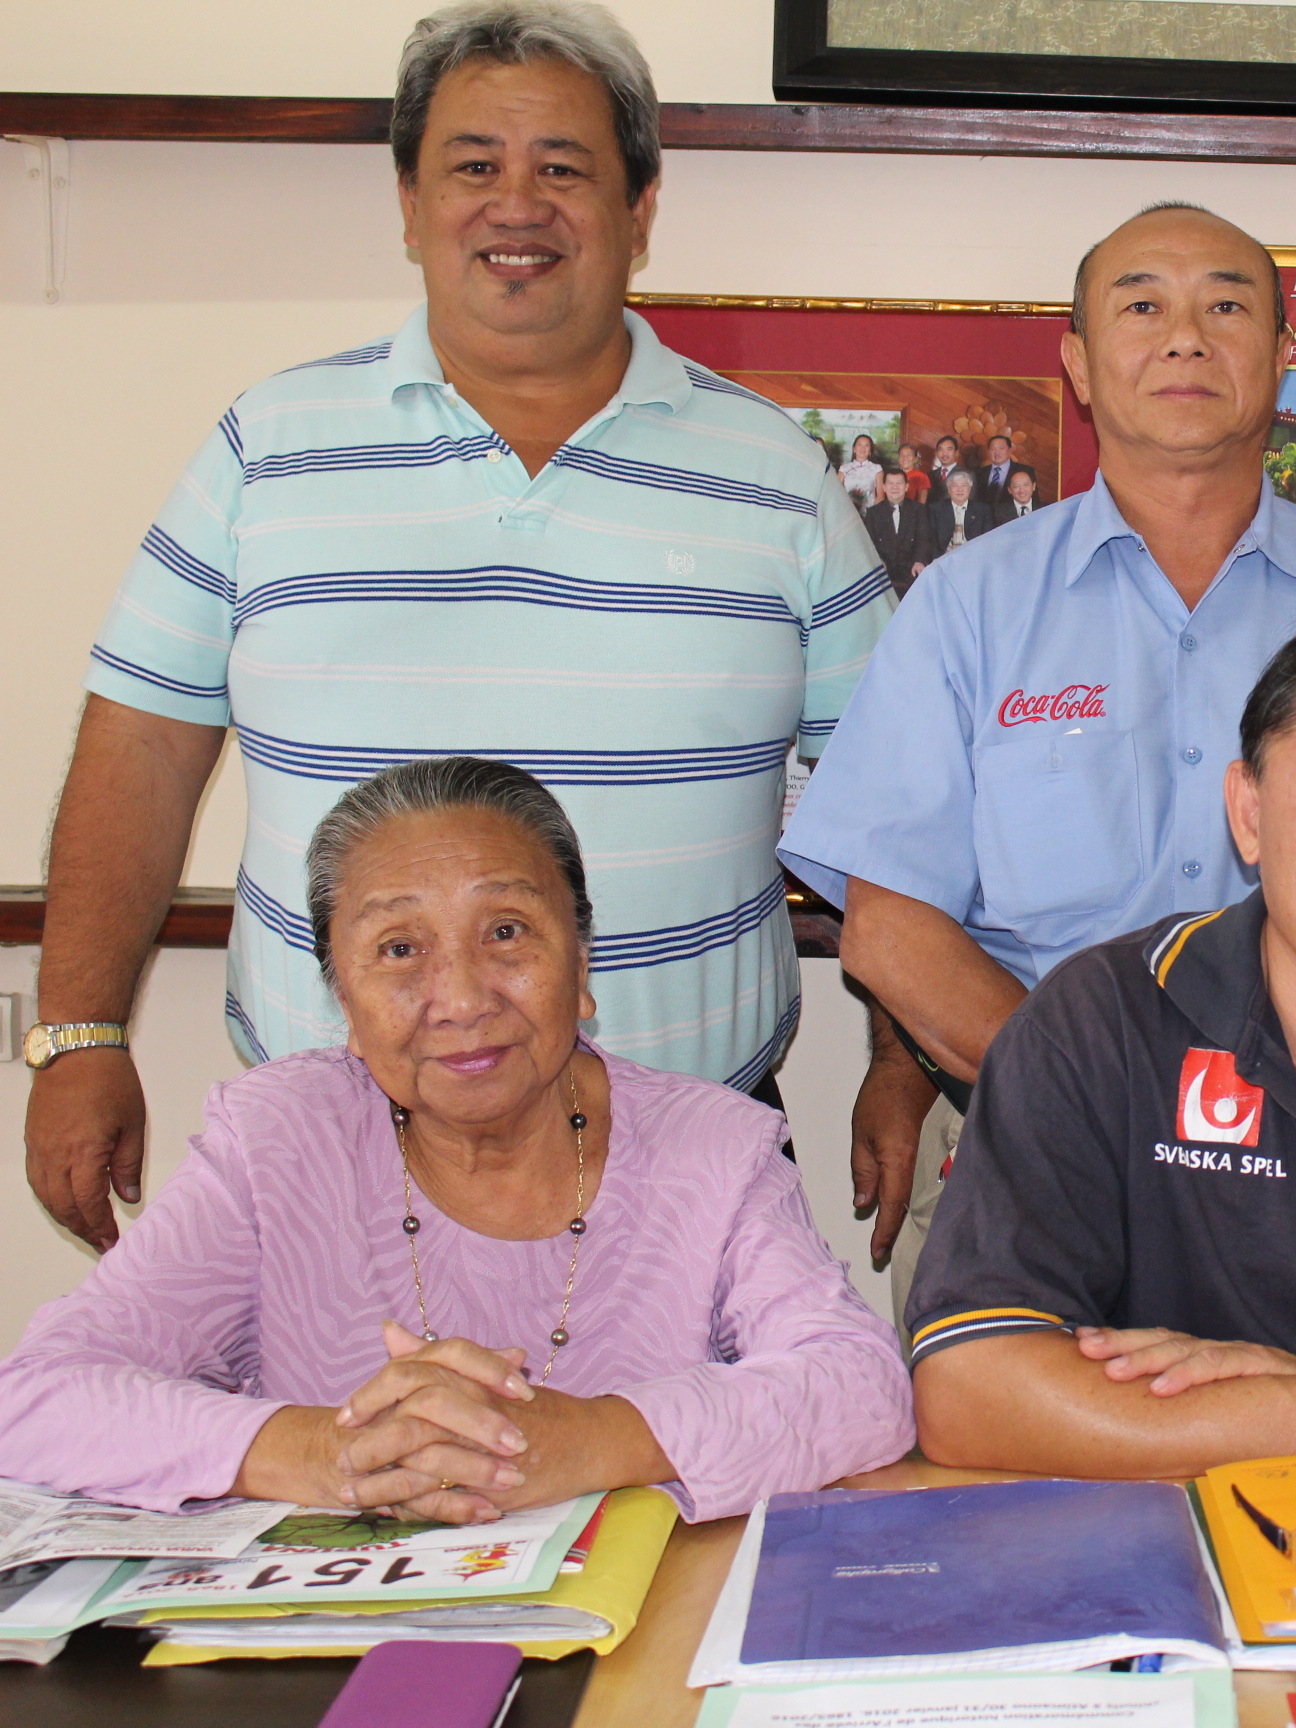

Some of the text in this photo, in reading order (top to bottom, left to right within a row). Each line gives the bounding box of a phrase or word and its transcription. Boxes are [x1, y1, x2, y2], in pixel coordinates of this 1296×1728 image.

[998, 684, 1110, 727] Coca-Cola
[1240, 1154, 1287, 1177] SPEL
[246, 1557, 425, 1590] 151
